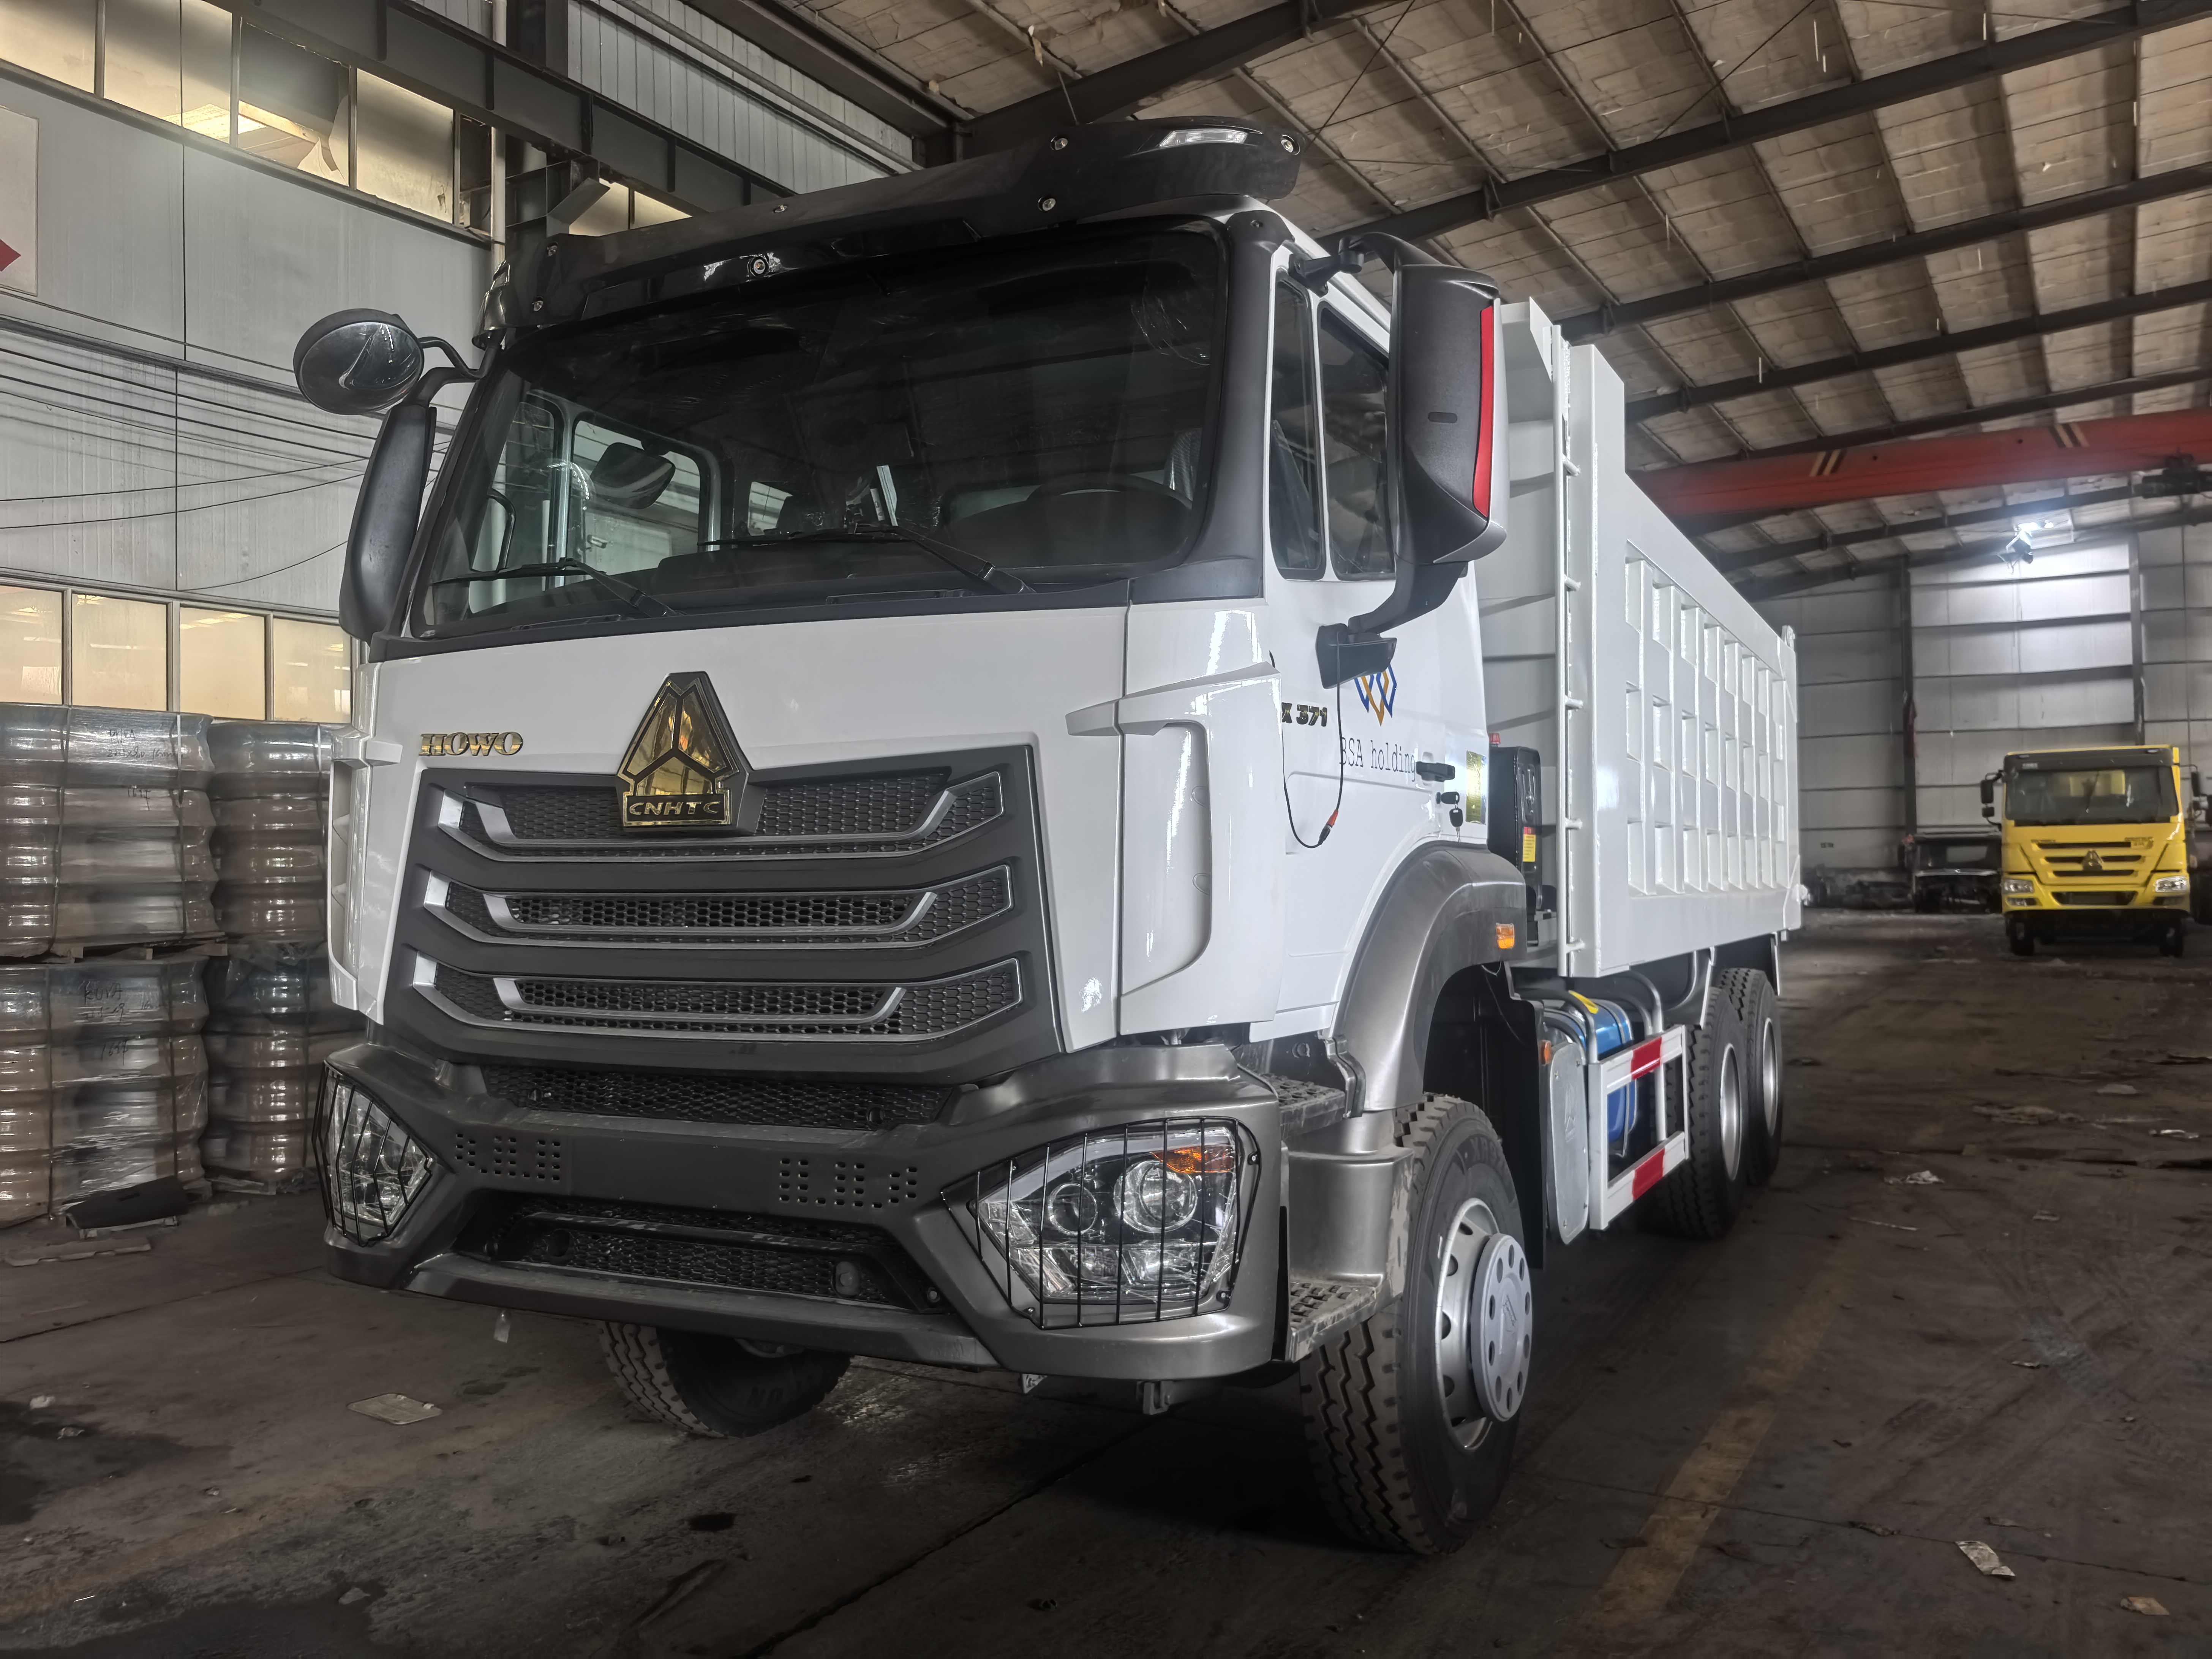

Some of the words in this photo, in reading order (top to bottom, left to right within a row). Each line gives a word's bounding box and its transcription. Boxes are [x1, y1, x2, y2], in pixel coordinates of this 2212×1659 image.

[1296, 704, 1327, 727] 371
[419, 732, 523, 756] HOWO
[1339, 737, 1364, 767] BSA
[1371, 740, 1416, 782] holding
[629, 801, 720, 815] CNHTC
